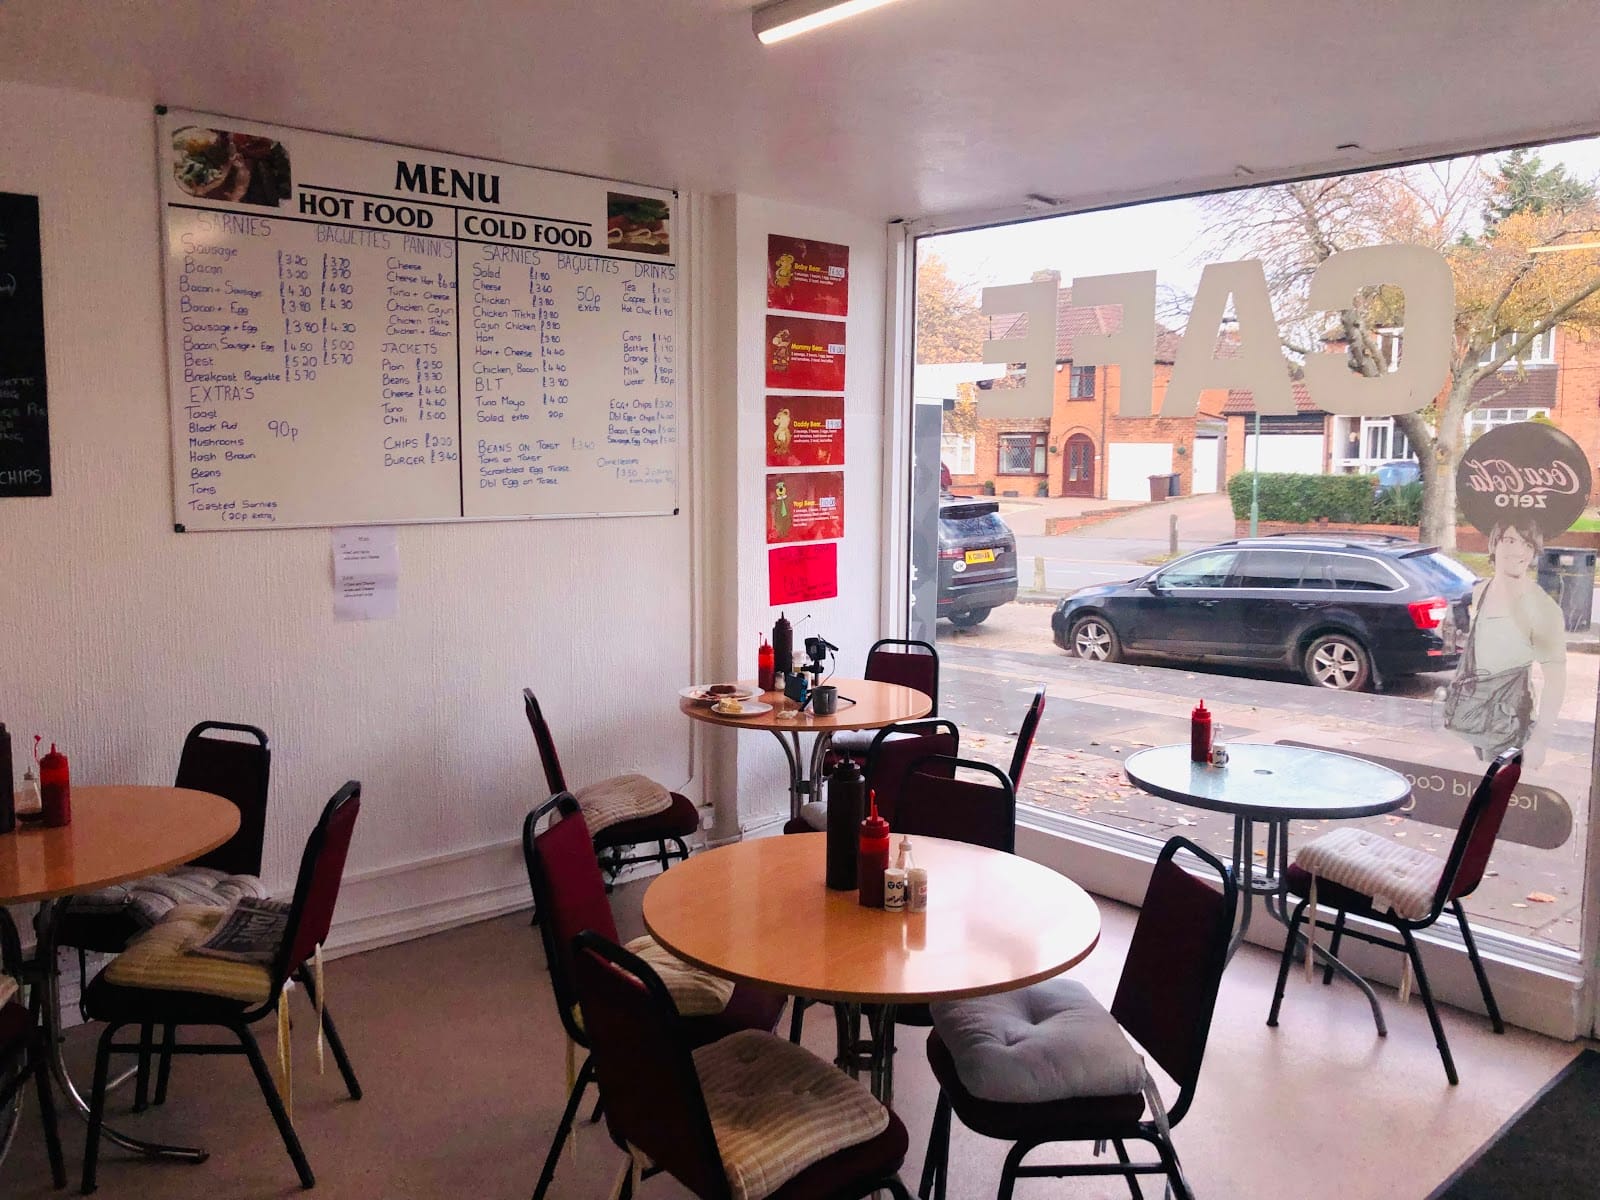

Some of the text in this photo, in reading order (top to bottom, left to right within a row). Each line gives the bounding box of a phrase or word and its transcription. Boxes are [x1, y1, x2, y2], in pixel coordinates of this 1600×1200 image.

[394, 160, 500, 204] MENU
[299, 192, 434, 229] HOT FOOD
[197, 212, 272, 237] SARNIES
[317, 224, 391, 250] BAGUETTES
[464, 215, 593, 248] COLD FOOD
[181, 233, 239, 261] Sausage
[185, 255, 223, 274] Bacon
[386, 257, 422, 270] Cheese
[482, 245, 620, 275] SARNIES BAGUETTES
[386, 270, 418, 283] Cheese
[473, 262, 501, 280] Salad
[386, 286, 410, 297] Tuna
[473, 279, 502, 291] Cheese
[621, 280, 637, 292] Tea
[474, 292, 511, 305] Chicken
[576, 286, 601, 305] 50p
[230, 302, 249, 316] Egg
[386, 299, 454, 317] Chicken Cajun
[473, 306, 509, 318] Chicken
[512, 309, 537, 320] Tikka
[621, 303, 634, 313] Hot
[183, 316, 231, 332] Sausage
[242, 321, 258, 334] Egg
[389, 314, 422, 325] Chicken
[474, 318, 537, 332] Cajun Chicken
[386, 324, 453, 338] Chicken Bacon
[476, 331, 495, 342] Ham
[622, 330, 643, 342] Cans
[380, 342, 439, 355] JACKETS
[475, 345, 494, 356] Ham
[504, 346, 534, 358] Cheese
[624, 343, 649, 353] Bottles
[184, 352, 215, 367] Best
[624, 353, 649, 366] Orange
[516, 362, 539, 373] Bacon
[184, 368, 238, 383] Breakfast
[244, 370, 281, 385] Baguette
[382, 372, 411, 386] Beans
[382, 387, 415, 399] Cheese
[380, 402, 403, 414] Tuna
[475, 395, 498, 407] Tuna
[501, 396, 526, 411] Mayo
[633, 399, 653, 410] Chips
[184, 405, 219, 419] Toast
[477, 410, 505, 423] Salad
[383, 414, 408, 425] Chilli
[188, 420, 239, 433] Black Pud
[267, 420, 299, 441] 90p
[189, 437, 245, 449] Mushrooms
[478, 439, 513, 454] BEANS
[190, 450, 257, 462] Hash Brown
[191, 467, 222, 479] Beans
[479, 465, 526, 477] Scrambled
[529, 465, 544, 475] Egg
[188, 482, 217, 495] Toms
[479, 478, 497, 489] Dbl
[502, 477, 520, 489] Egg
[187, 499, 278, 511] Toasted Sarnies
